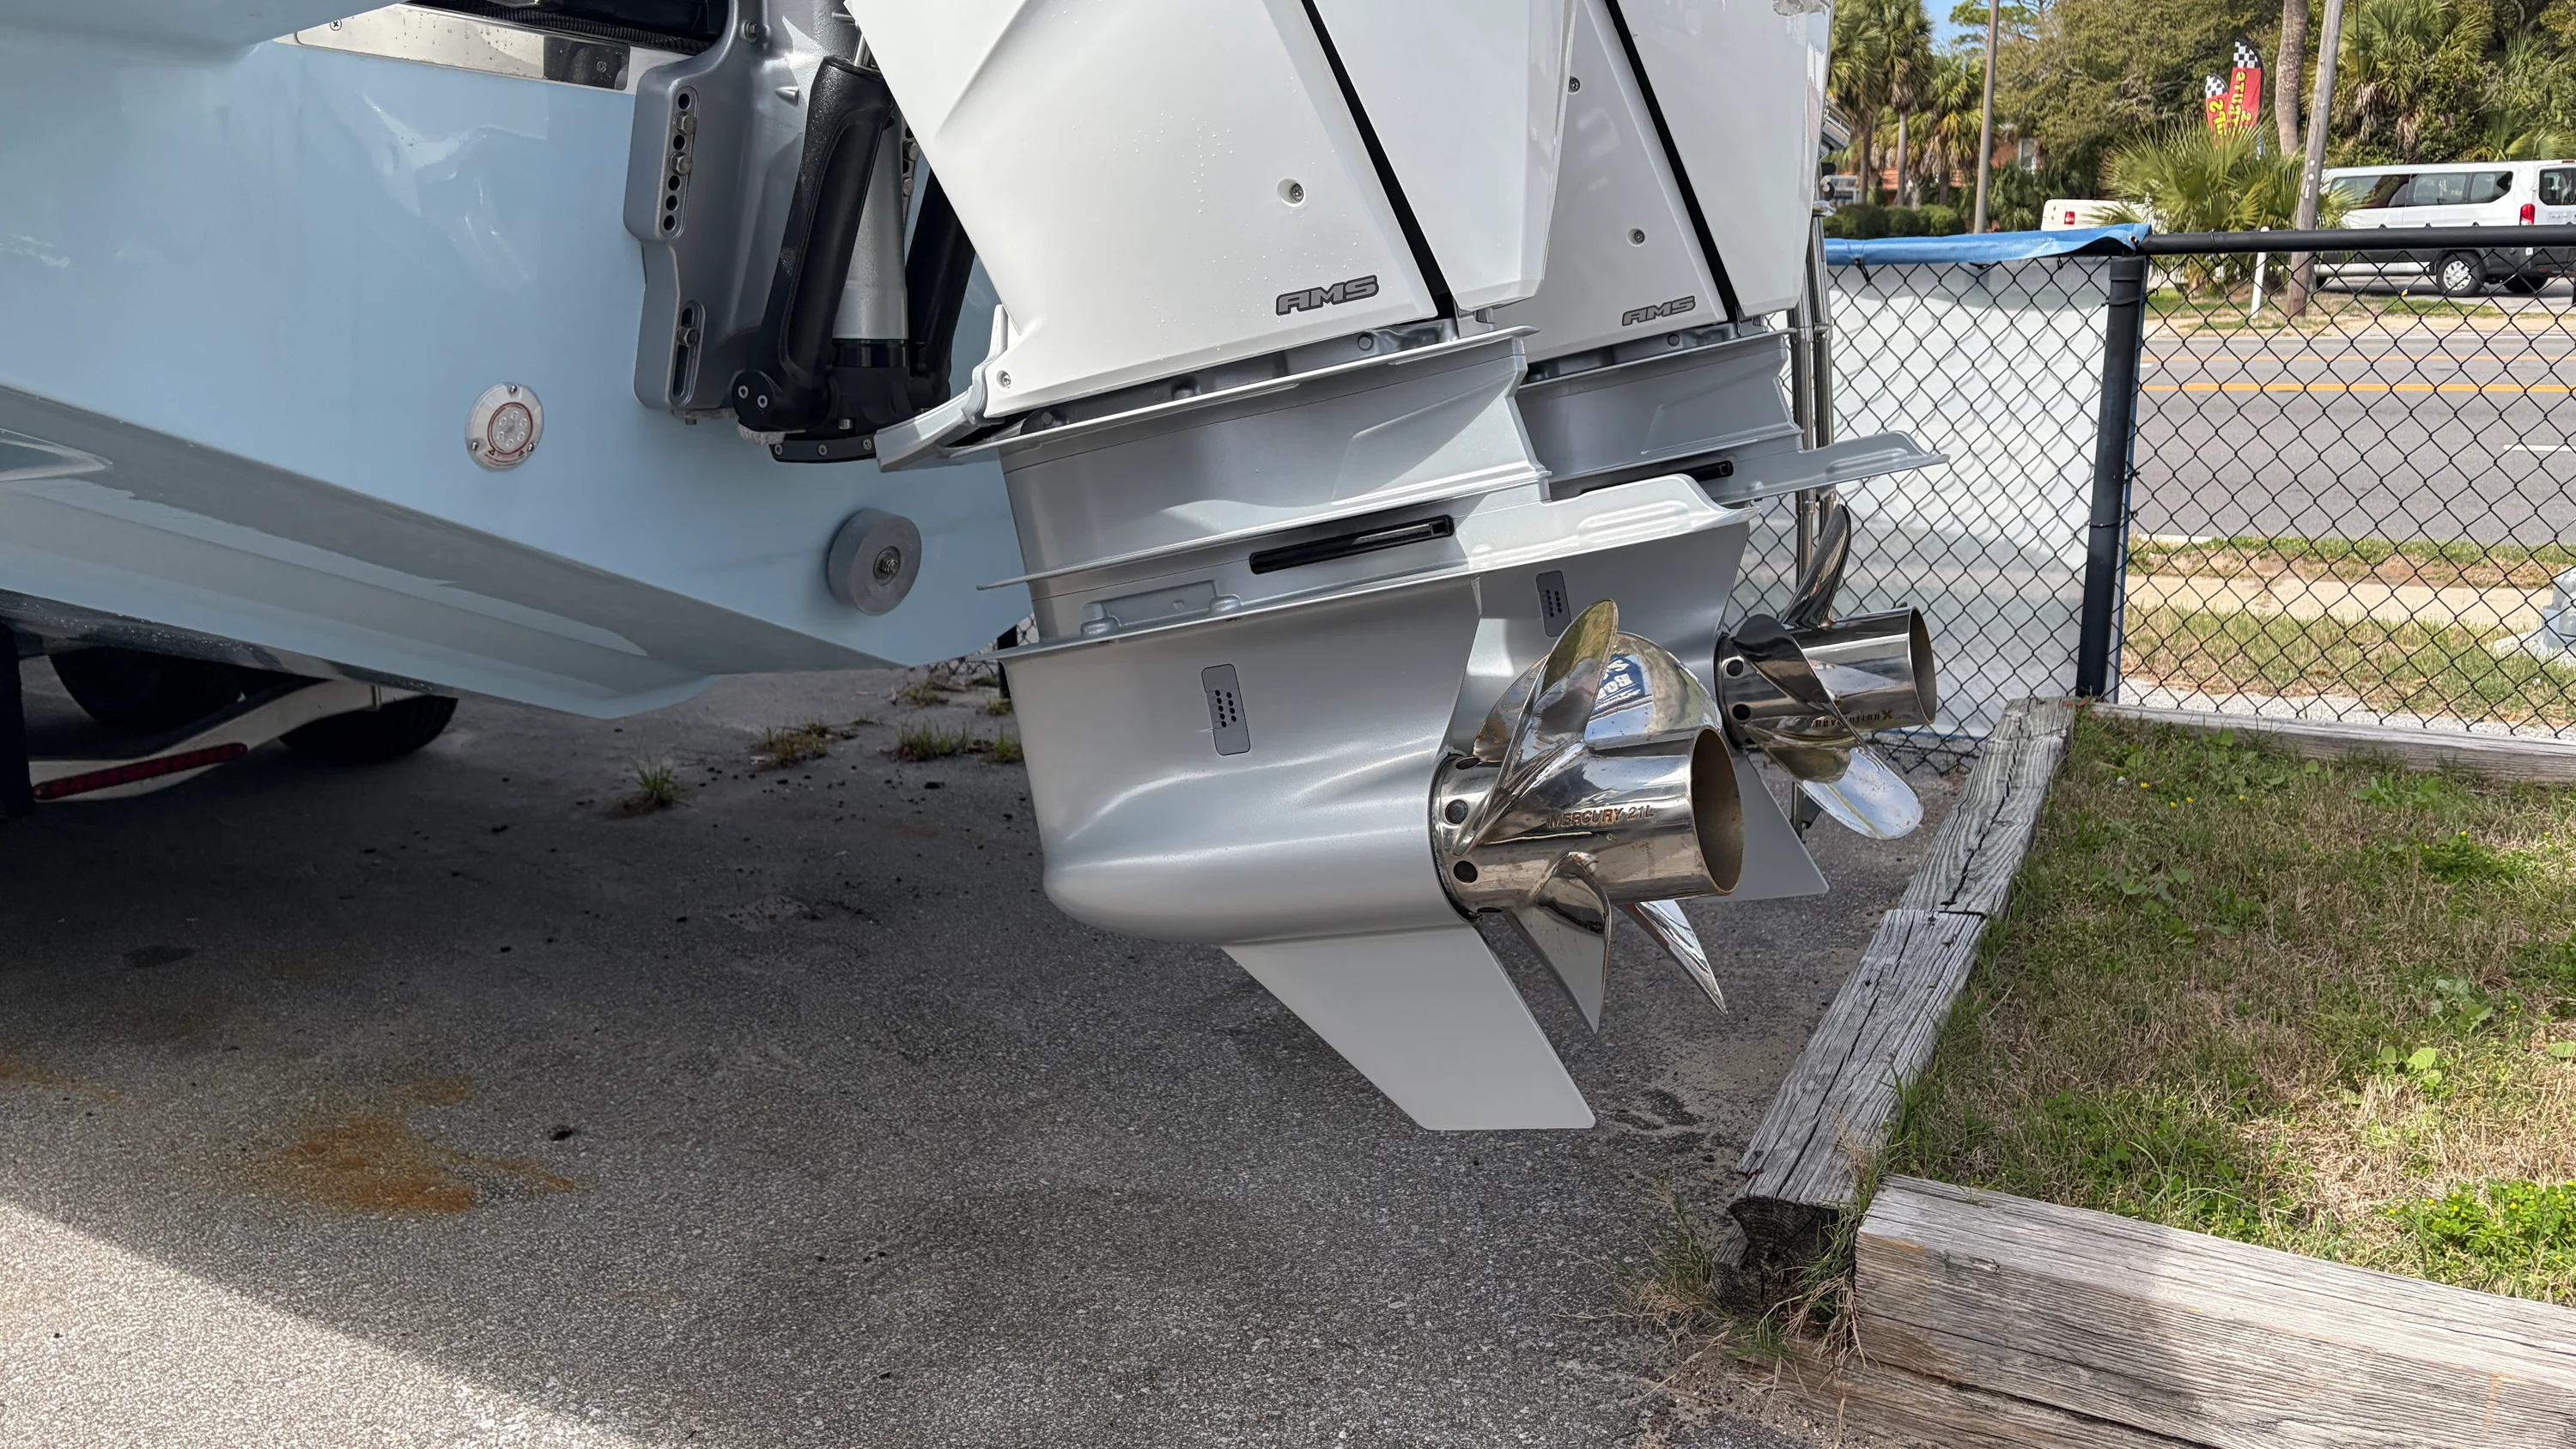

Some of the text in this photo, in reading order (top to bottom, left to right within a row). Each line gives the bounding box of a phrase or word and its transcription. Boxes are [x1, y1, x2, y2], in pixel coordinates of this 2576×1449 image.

[1276, 275, 1379, 316] AMS
[1622, 295, 1696, 326] AMS
[1549, 805, 1655, 828] MERCURY 21L
